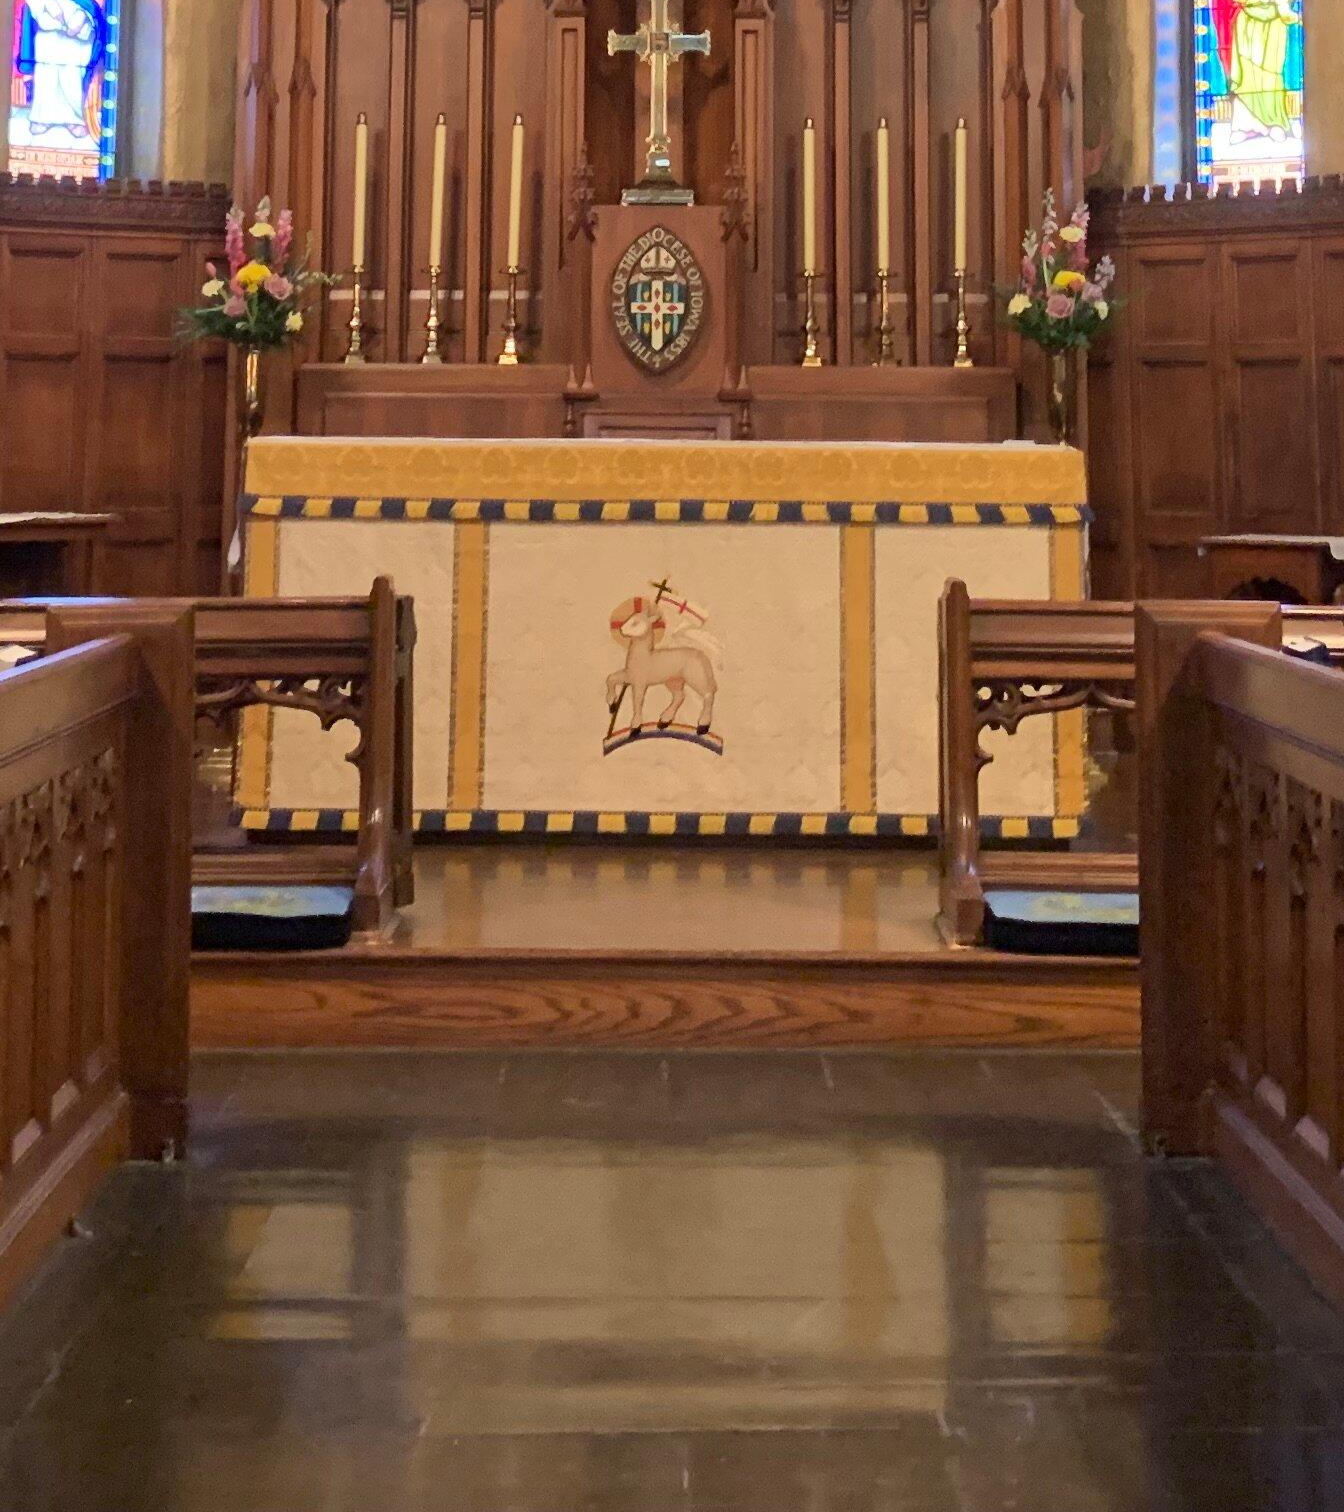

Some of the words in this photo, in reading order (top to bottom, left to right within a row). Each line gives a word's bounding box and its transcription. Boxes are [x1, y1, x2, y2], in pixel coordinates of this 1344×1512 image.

[618, 244, 642, 274] THE
[638, 227, 694, 267] DIOCESE
[612, 271, 628, 294] OF
[612, 296, 632, 336] SEAL
[684, 292, 704, 332] IOWA
[628, 338, 652, 363] THE
